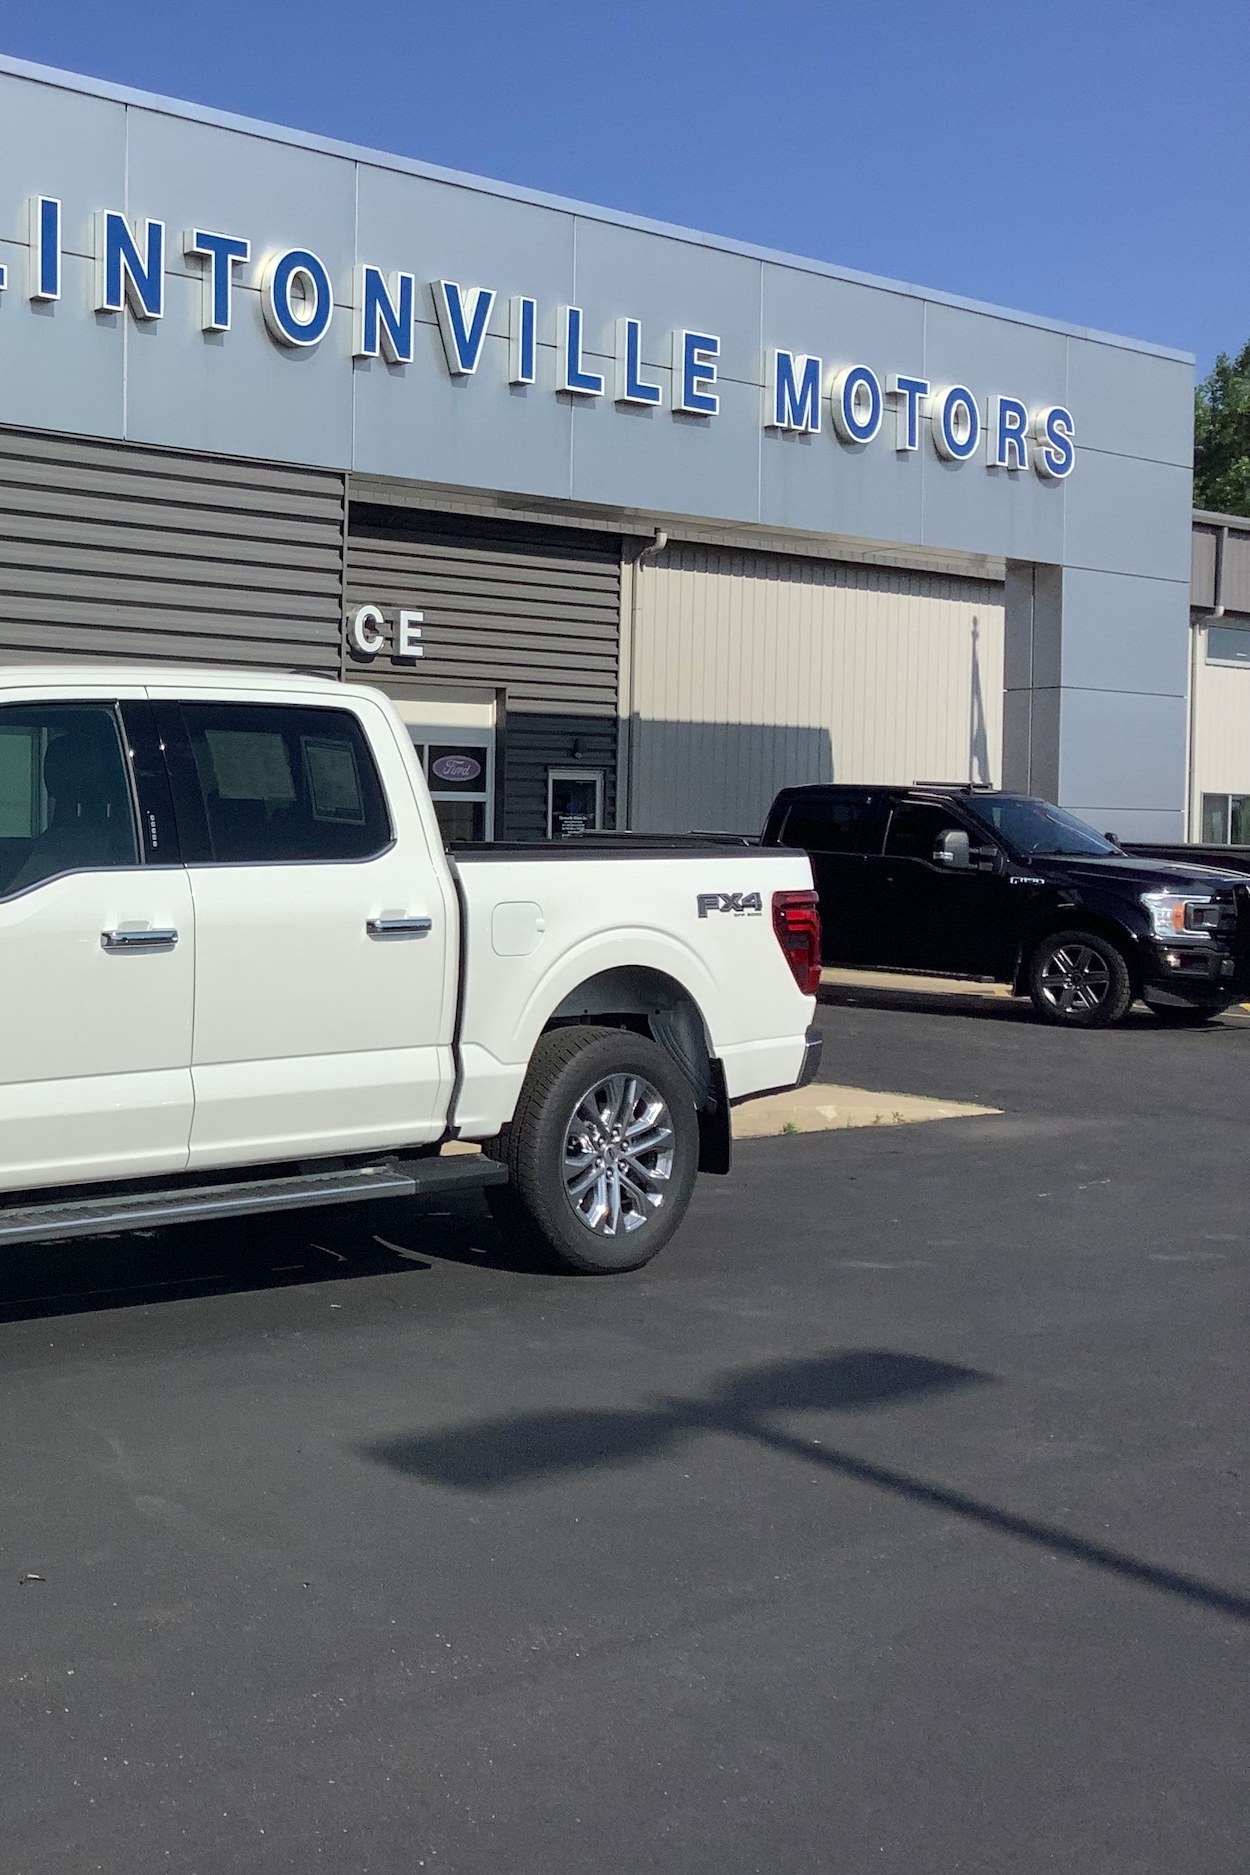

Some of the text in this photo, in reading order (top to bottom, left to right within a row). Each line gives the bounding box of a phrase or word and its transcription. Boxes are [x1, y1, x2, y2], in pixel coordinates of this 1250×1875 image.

[764, 348, 1075, 478] MOTORS
[353, 604, 425, 656] CE
[442, 759, 471, 776] Ford
[697, 892, 763, 918] FX4
